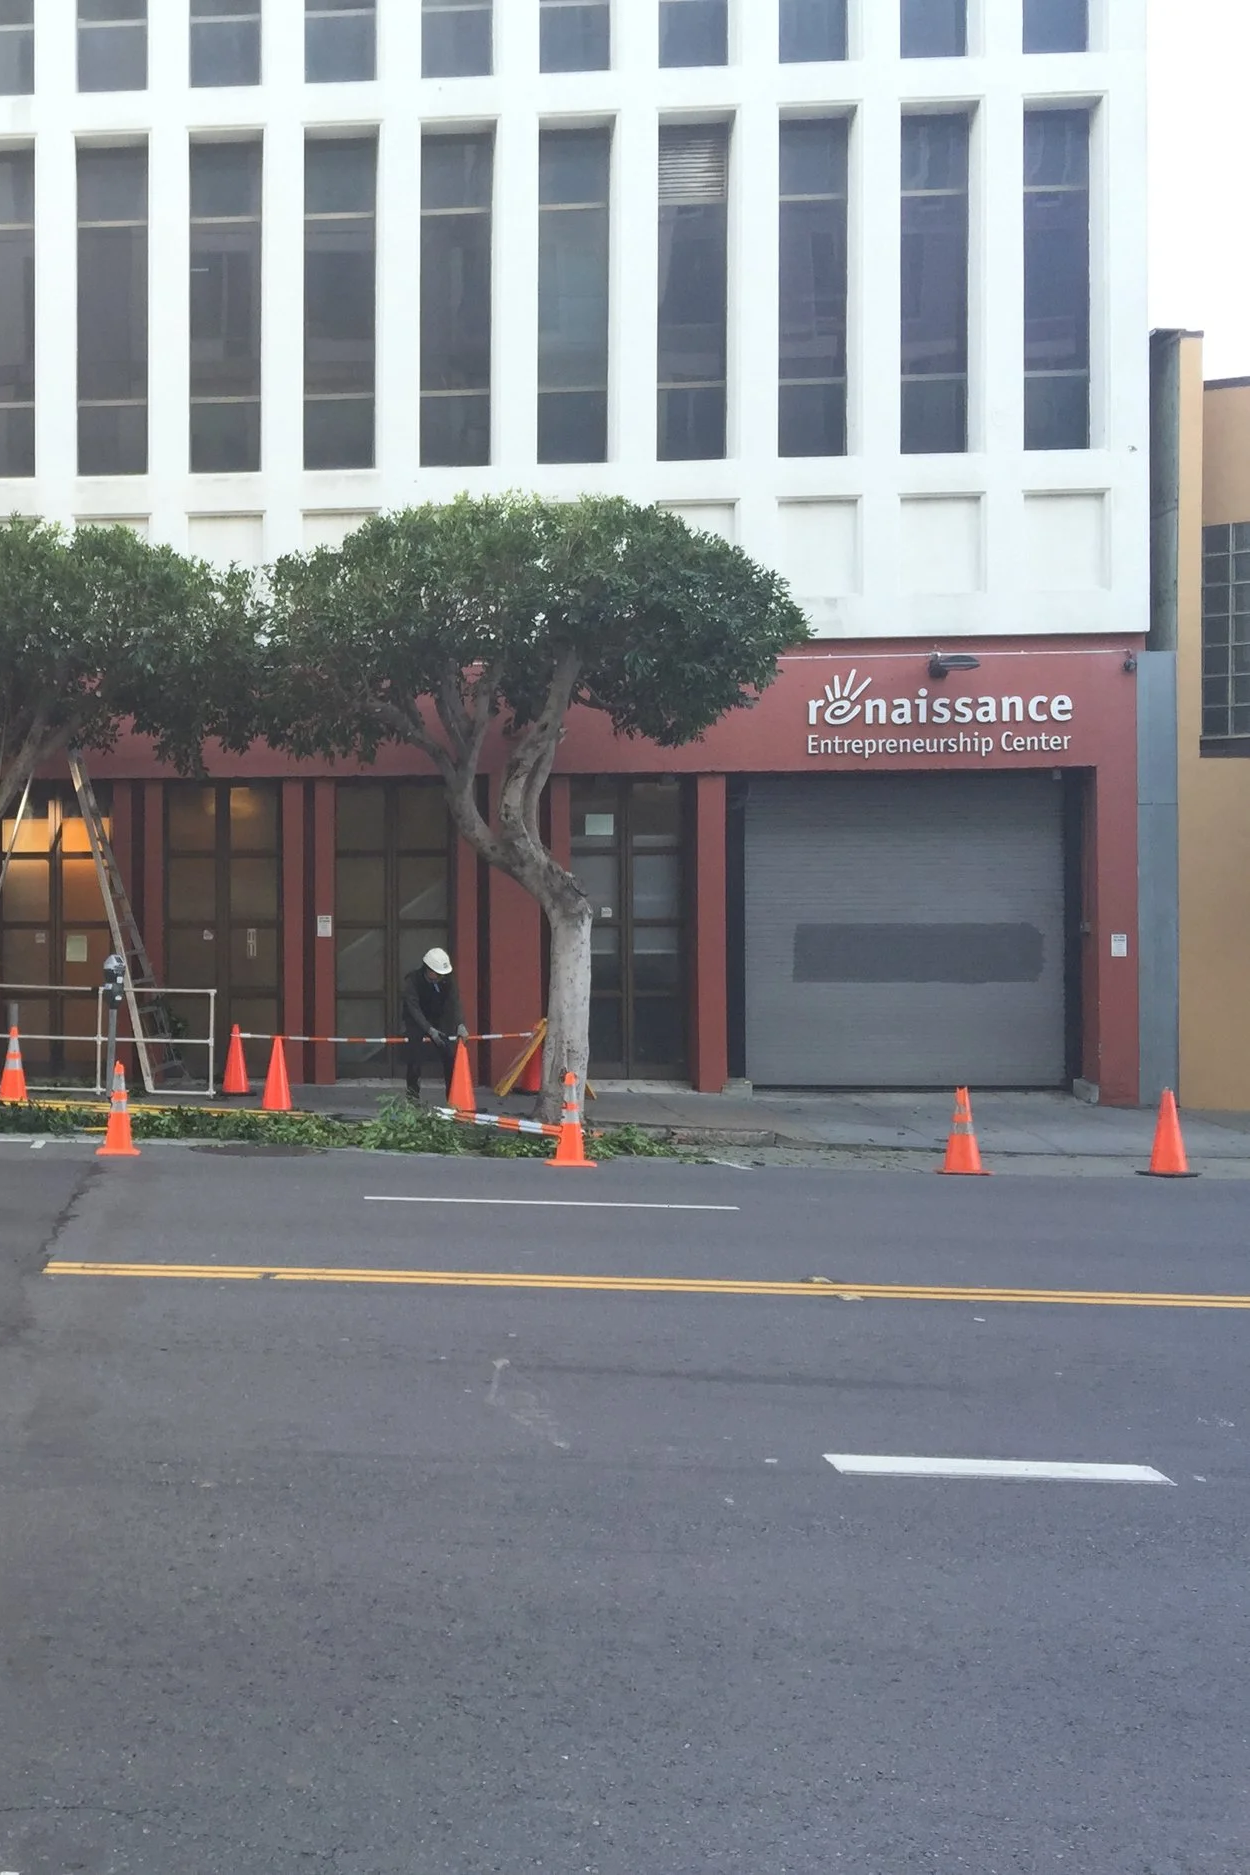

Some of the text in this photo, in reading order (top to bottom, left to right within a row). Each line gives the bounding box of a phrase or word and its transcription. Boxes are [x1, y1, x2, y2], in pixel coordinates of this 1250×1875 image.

[808, 684, 1073, 726] renaissance
[807, 731, 1072, 758] Entrepreneurship Center
